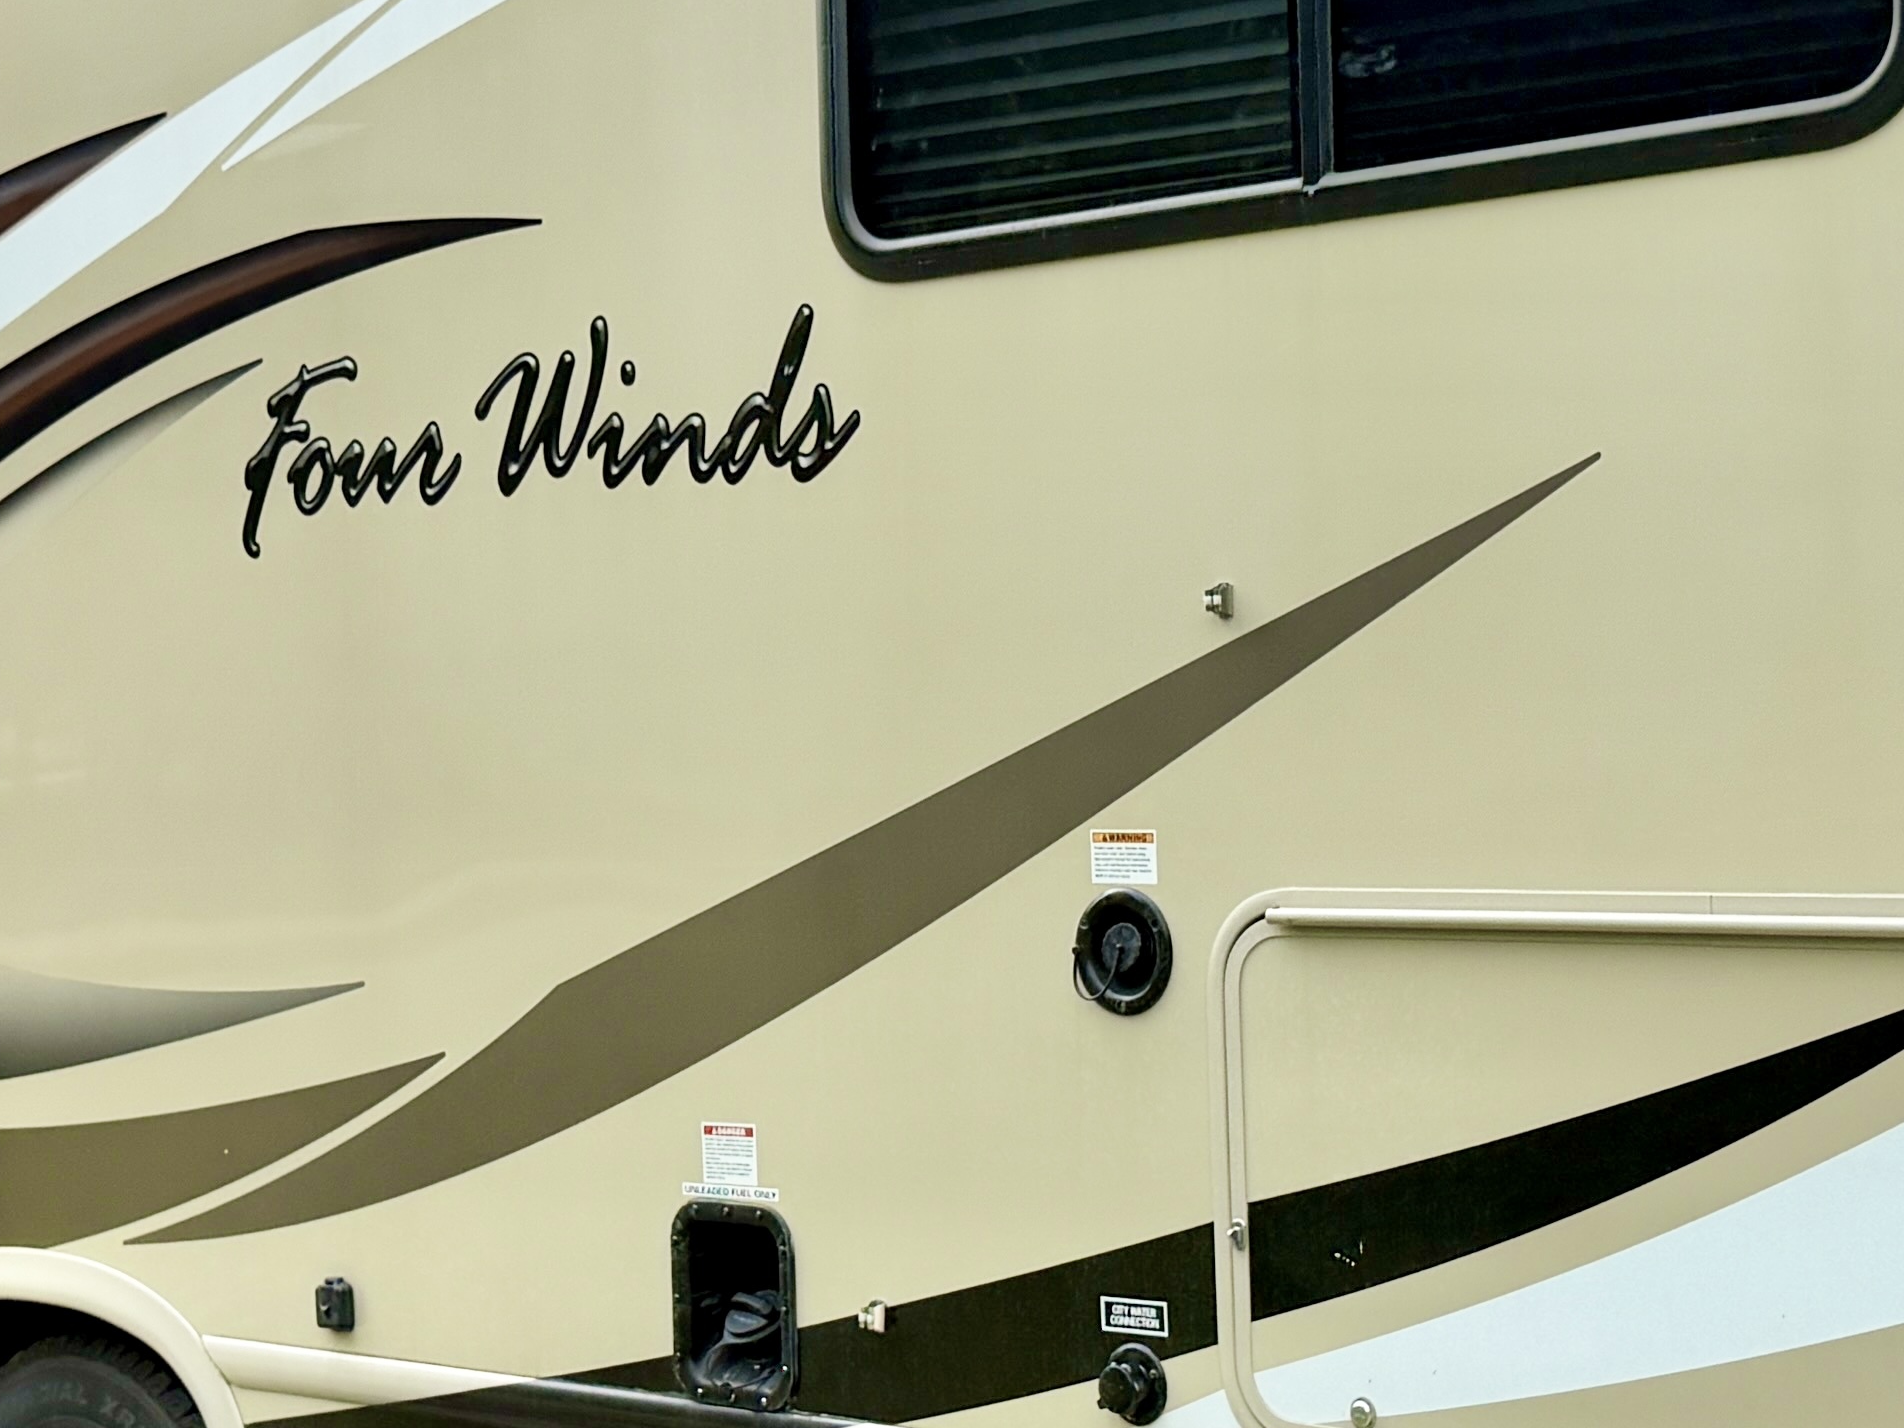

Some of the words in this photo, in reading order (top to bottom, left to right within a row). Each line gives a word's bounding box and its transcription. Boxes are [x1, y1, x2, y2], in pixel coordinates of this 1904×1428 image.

[243, 356, 461, 559] Four
[475, 304, 860, 497] Winds
[684, 1184, 730, 1197] UNLEADED
[731, 1188, 752, 1198] FUEL
[753, 1189, 777, 1200] ONLY
